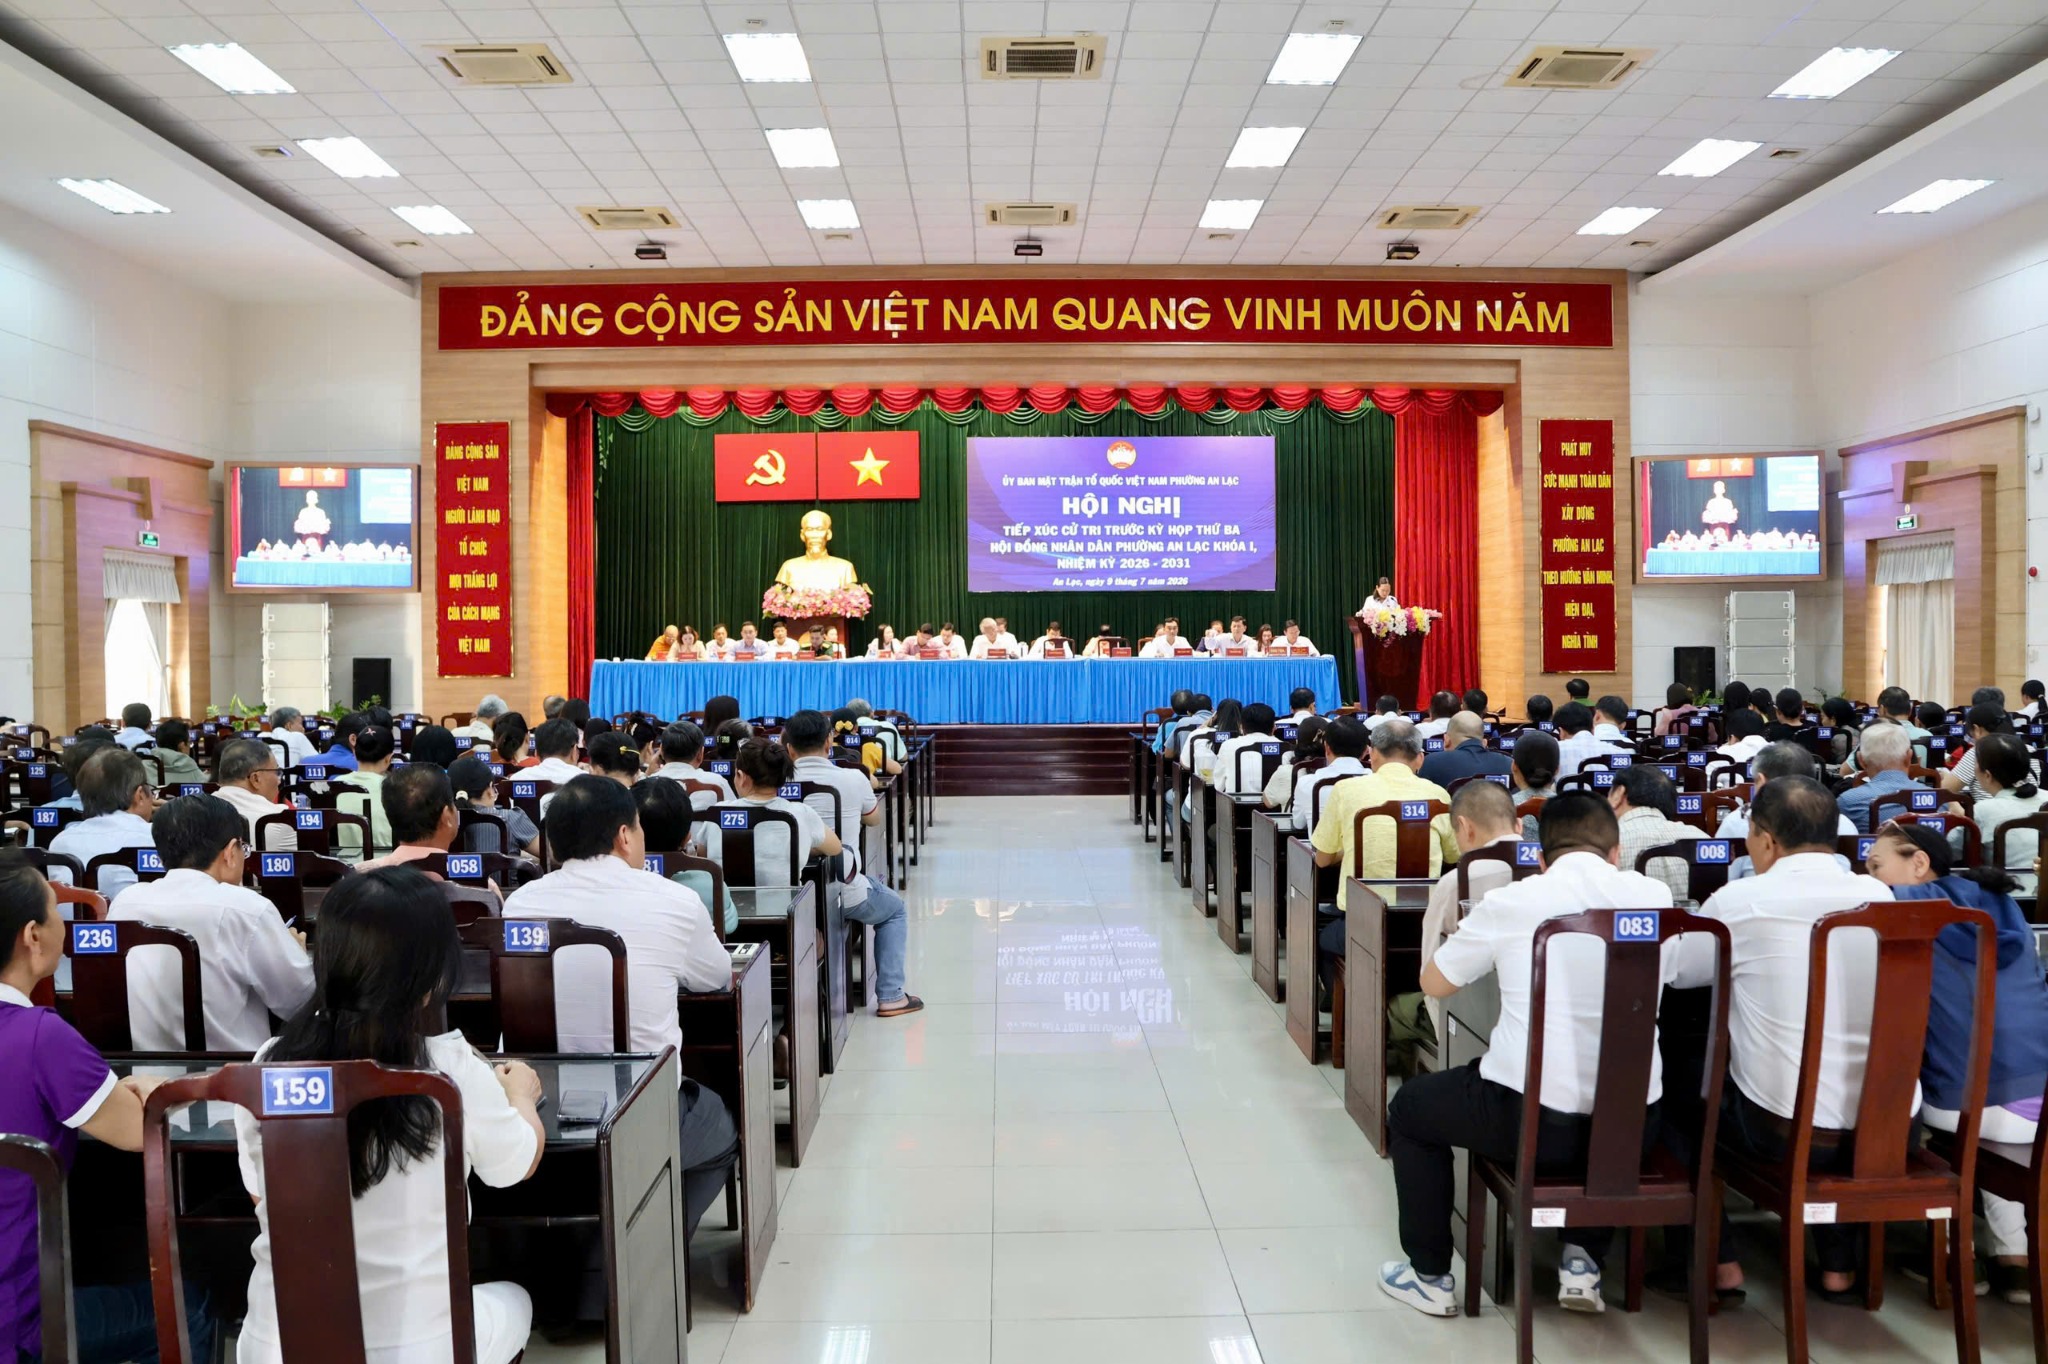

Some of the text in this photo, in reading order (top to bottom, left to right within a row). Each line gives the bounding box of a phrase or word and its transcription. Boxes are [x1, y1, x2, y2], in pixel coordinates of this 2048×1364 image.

[480, 288, 1570, 341] ĐẢNG CỘNG SẢN VIỆT NAM QUANG VINH MUÔN NĂM
[446, 439, 499, 462] ĐẢNG CỘNG SẢN
[1561, 438, 1592, 456] PHÁT HUY
[456, 474, 489, 494] VIỆT NAM
[1002, 473, 1240, 488] ỦY BAN MẶT TRẬN TỔ QUỐC VIỆT NAM PHƯỜNG AN LẠC
[1544, 470, 1558, 488] SỨC
[1558, 474, 1578, 491] MẠNH
[1580, 470, 1597, 488] TOÀN
[1062, 492, 1181, 519] HỘI NGHỊ
[1562, 503, 1595, 523] XÂY DỰNG
[446, 505, 466, 524] NGƯỜI
[486, 509, 500, 526] ĐẠO
[1003, 522, 1240, 538] TIẾP XÚC CỬ TRI TRƯỚC KỲ HỌP THỨ BA
[459, 536, 488, 556] TỔ CHỨC
[990, 538, 1258, 554] HỘI ĐỒNG NHÂN DÂN PHƯỜNG AN LẠC KHÓA I,
[1552, 534, 1604, 555] PHƯỜNG AN LẠC
[1056, 556, 1096, 571] NHIỆM
[1100, 556, 1116, 570] KỲ
[1120, 558, 1150, 569] 2026
[1161, 558, 1191, 568] 2031
[449, 569, 498, 591] MỌI THẮNG LỢI
[1052, 578, 1064, 586] An
[1066, 578, 1084, 587] Lạc,
[1086, 577, 1104, 588] ngày
[1106, 576, 1114, 586] 9
[1140, 576, 1146, 586] 7
[1166, 576, 1188, 586] 2026
[1543, 570, 1559, 585] THEO
[1560, 566, 1582, 585] HƯỚNG
[448, 601, 500, 623] CỦA CÁCH MẠNG
[1564, 600, 1580, 620] HIỆN
[458, 634, 490, 655] VIỆT NAM
[1583, 631, 1598, 649] TÌNH
[846, 736, 859, 744] 014
[1286, 730, 1297, 738] 141
[18, 750, 31, 758] 267
[1613, 757, 1628, 766] 288
[1690, 754, 1704, 763] 204
[30, 766, 44, 776] 125
[308, 768, 322, 777] 111
[713, 764, 728, 773] 169
[1596, 776, 1614, 785] 332
[515, 786, 533, 795] 021
[780, 786, 799, 796] 212
[1680, 798, 1700, 810] 318
[1915, 794, 1934, 806] 100
[36, 810, 56, 824] 187
[1404, 802, 1426, 818] 314
[300, 814, 320, 827] 194
[724, 813, 745, 826] 275
[1520, 846, 1540, 861] 24
[1700, 844, 1725, 859] 008
[266, 857, 291, 873] 180
[450, 858, 478, 874] 058
[644, 858, 660, 872] 81
[1618, 916, 1654, 936] 083
[78, 929, 113, 948] 236
[510, 926, 544, 946] 139
[272, 1076, 326, 1107] 159
